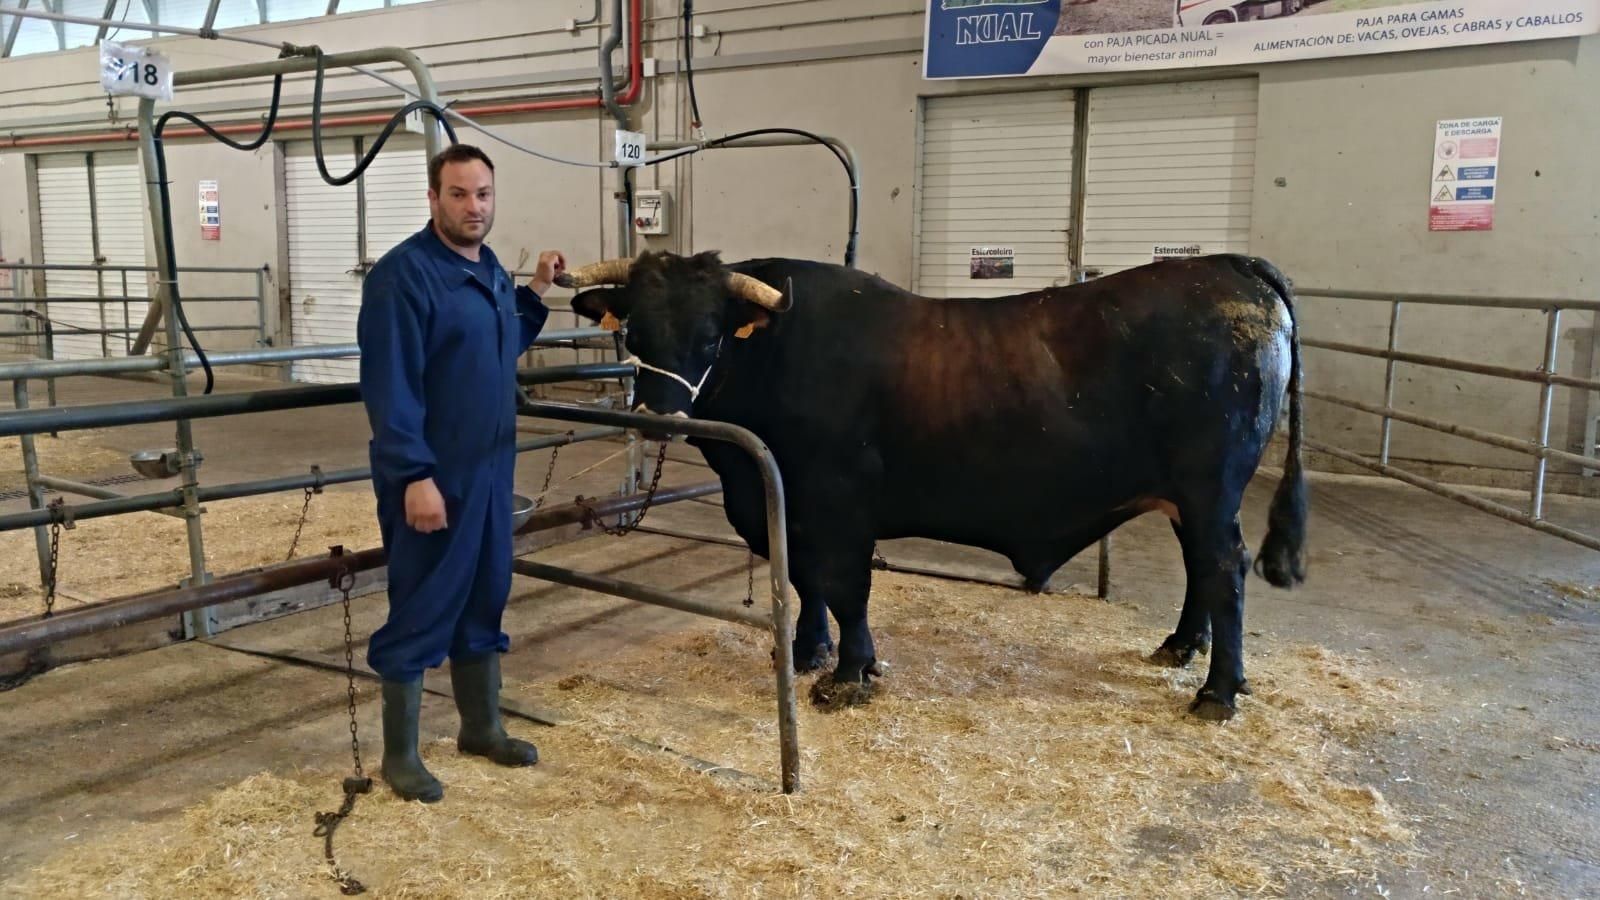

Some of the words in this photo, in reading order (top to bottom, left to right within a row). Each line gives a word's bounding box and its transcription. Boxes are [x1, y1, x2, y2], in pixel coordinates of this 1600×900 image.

[1356, 16, 1384, 28] PAJA
[1387, 12, 1417, 24] PARA
[1420, 8, 1465, 22] CAMAS
[956, 12, 1041, 45] NUAL
[1253, 34, 1334, 51] ALIMENTACIÓN
[1337, 32, 1355, 44] DE:
[1357, 28, 1398, 42] VACAS,
[1401, 24, 1450, 38] OVEJAS,
[1453, 19, 1502, 33] CABRAS
[1505, 20, 1513, 31] y
[1515, 11, 1584, 28] CABALLOS
[1083, 39, 1104, 49] con
[1106, 36, 1133, 48] PAJA
[1135, 33, 1178, 46] PICADA
[1180, 30, 1213, 42] NUAL
[1087, 53, 1122, 65] mayor
[1124, 49, 1176, 62] bienestar
[1178, 46, 1218, 60] animal
[1450, 128, 1492, 137] DESCARGA
[1472, 119, 1499, 127] CARGA
[621, 142, 641, 160] 120
[971, 247, 1013, 256] Estercoleiro
